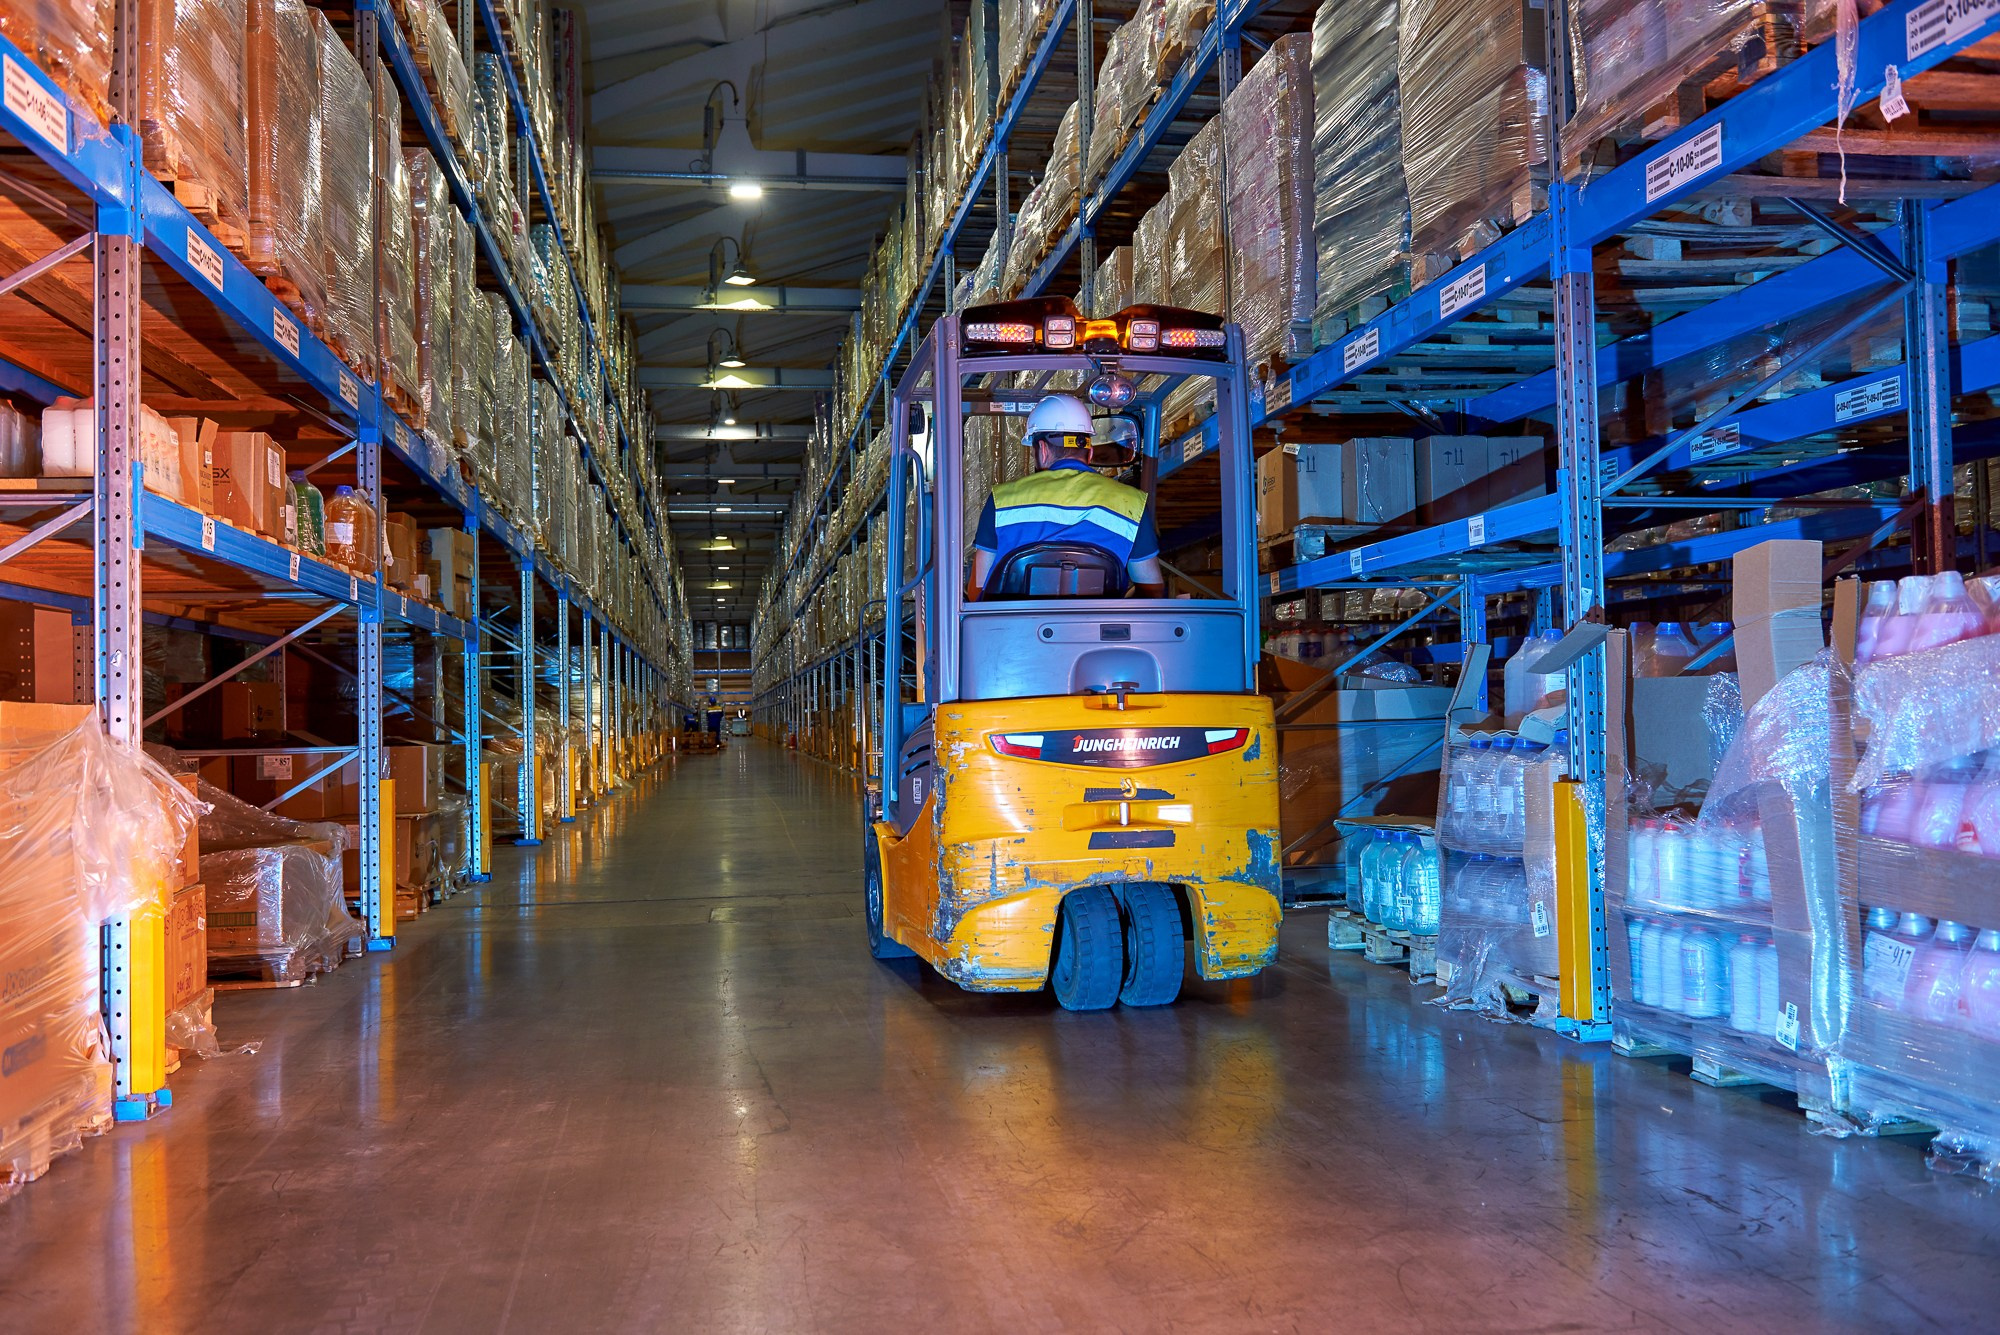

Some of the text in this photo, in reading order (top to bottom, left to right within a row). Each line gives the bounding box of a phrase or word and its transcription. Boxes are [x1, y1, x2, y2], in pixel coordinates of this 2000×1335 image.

[1945, 0, 1986, 24] C-10-0
[1669, 151, 1694, 178] C-10-06
[1073, 736, 1181, 753] JUNGHEINRICH
[1891, 945, 1912, 968] 917
